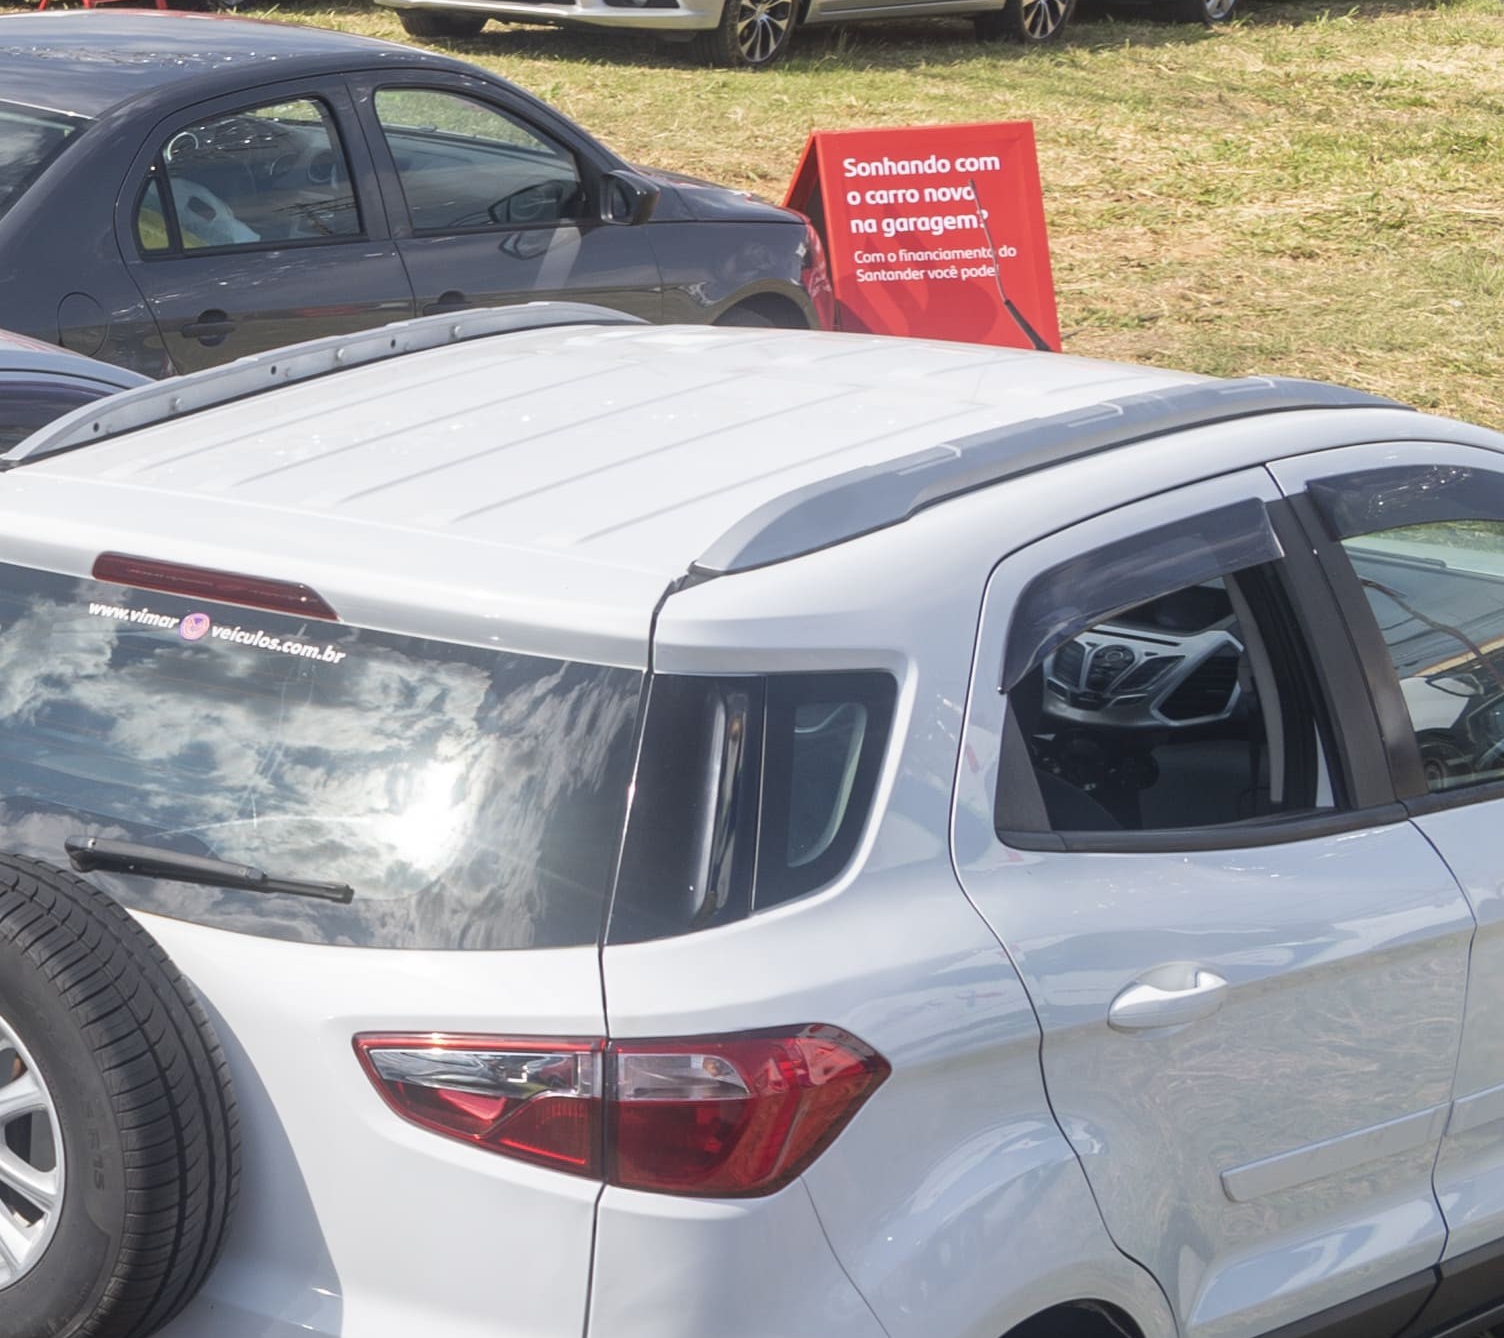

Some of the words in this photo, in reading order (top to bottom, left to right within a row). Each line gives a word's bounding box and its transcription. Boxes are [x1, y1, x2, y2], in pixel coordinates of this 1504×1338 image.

[842, 155, 951, 178] Sonhando
[954, 155, 1001, 172] com
[846, 190, 862, 205] o
[865, 188, 920, 205] carro
[924, 185, 976, 203] novo
[850, 219, 878, 235] na
[881, 209, 989, 238] garagem?
[854, 250, 886, 265] Com
[887, 251, 898, 263] o
[899, 246, 995, 262] financiamento
[998, 245, 1017, 258] do
[856, 268, 926, 283] Santander
[927, 264, 959, 279] você
[88, 601, 180, 629] www.vimar
[211, 623, 347, 664] veículos.com.br
